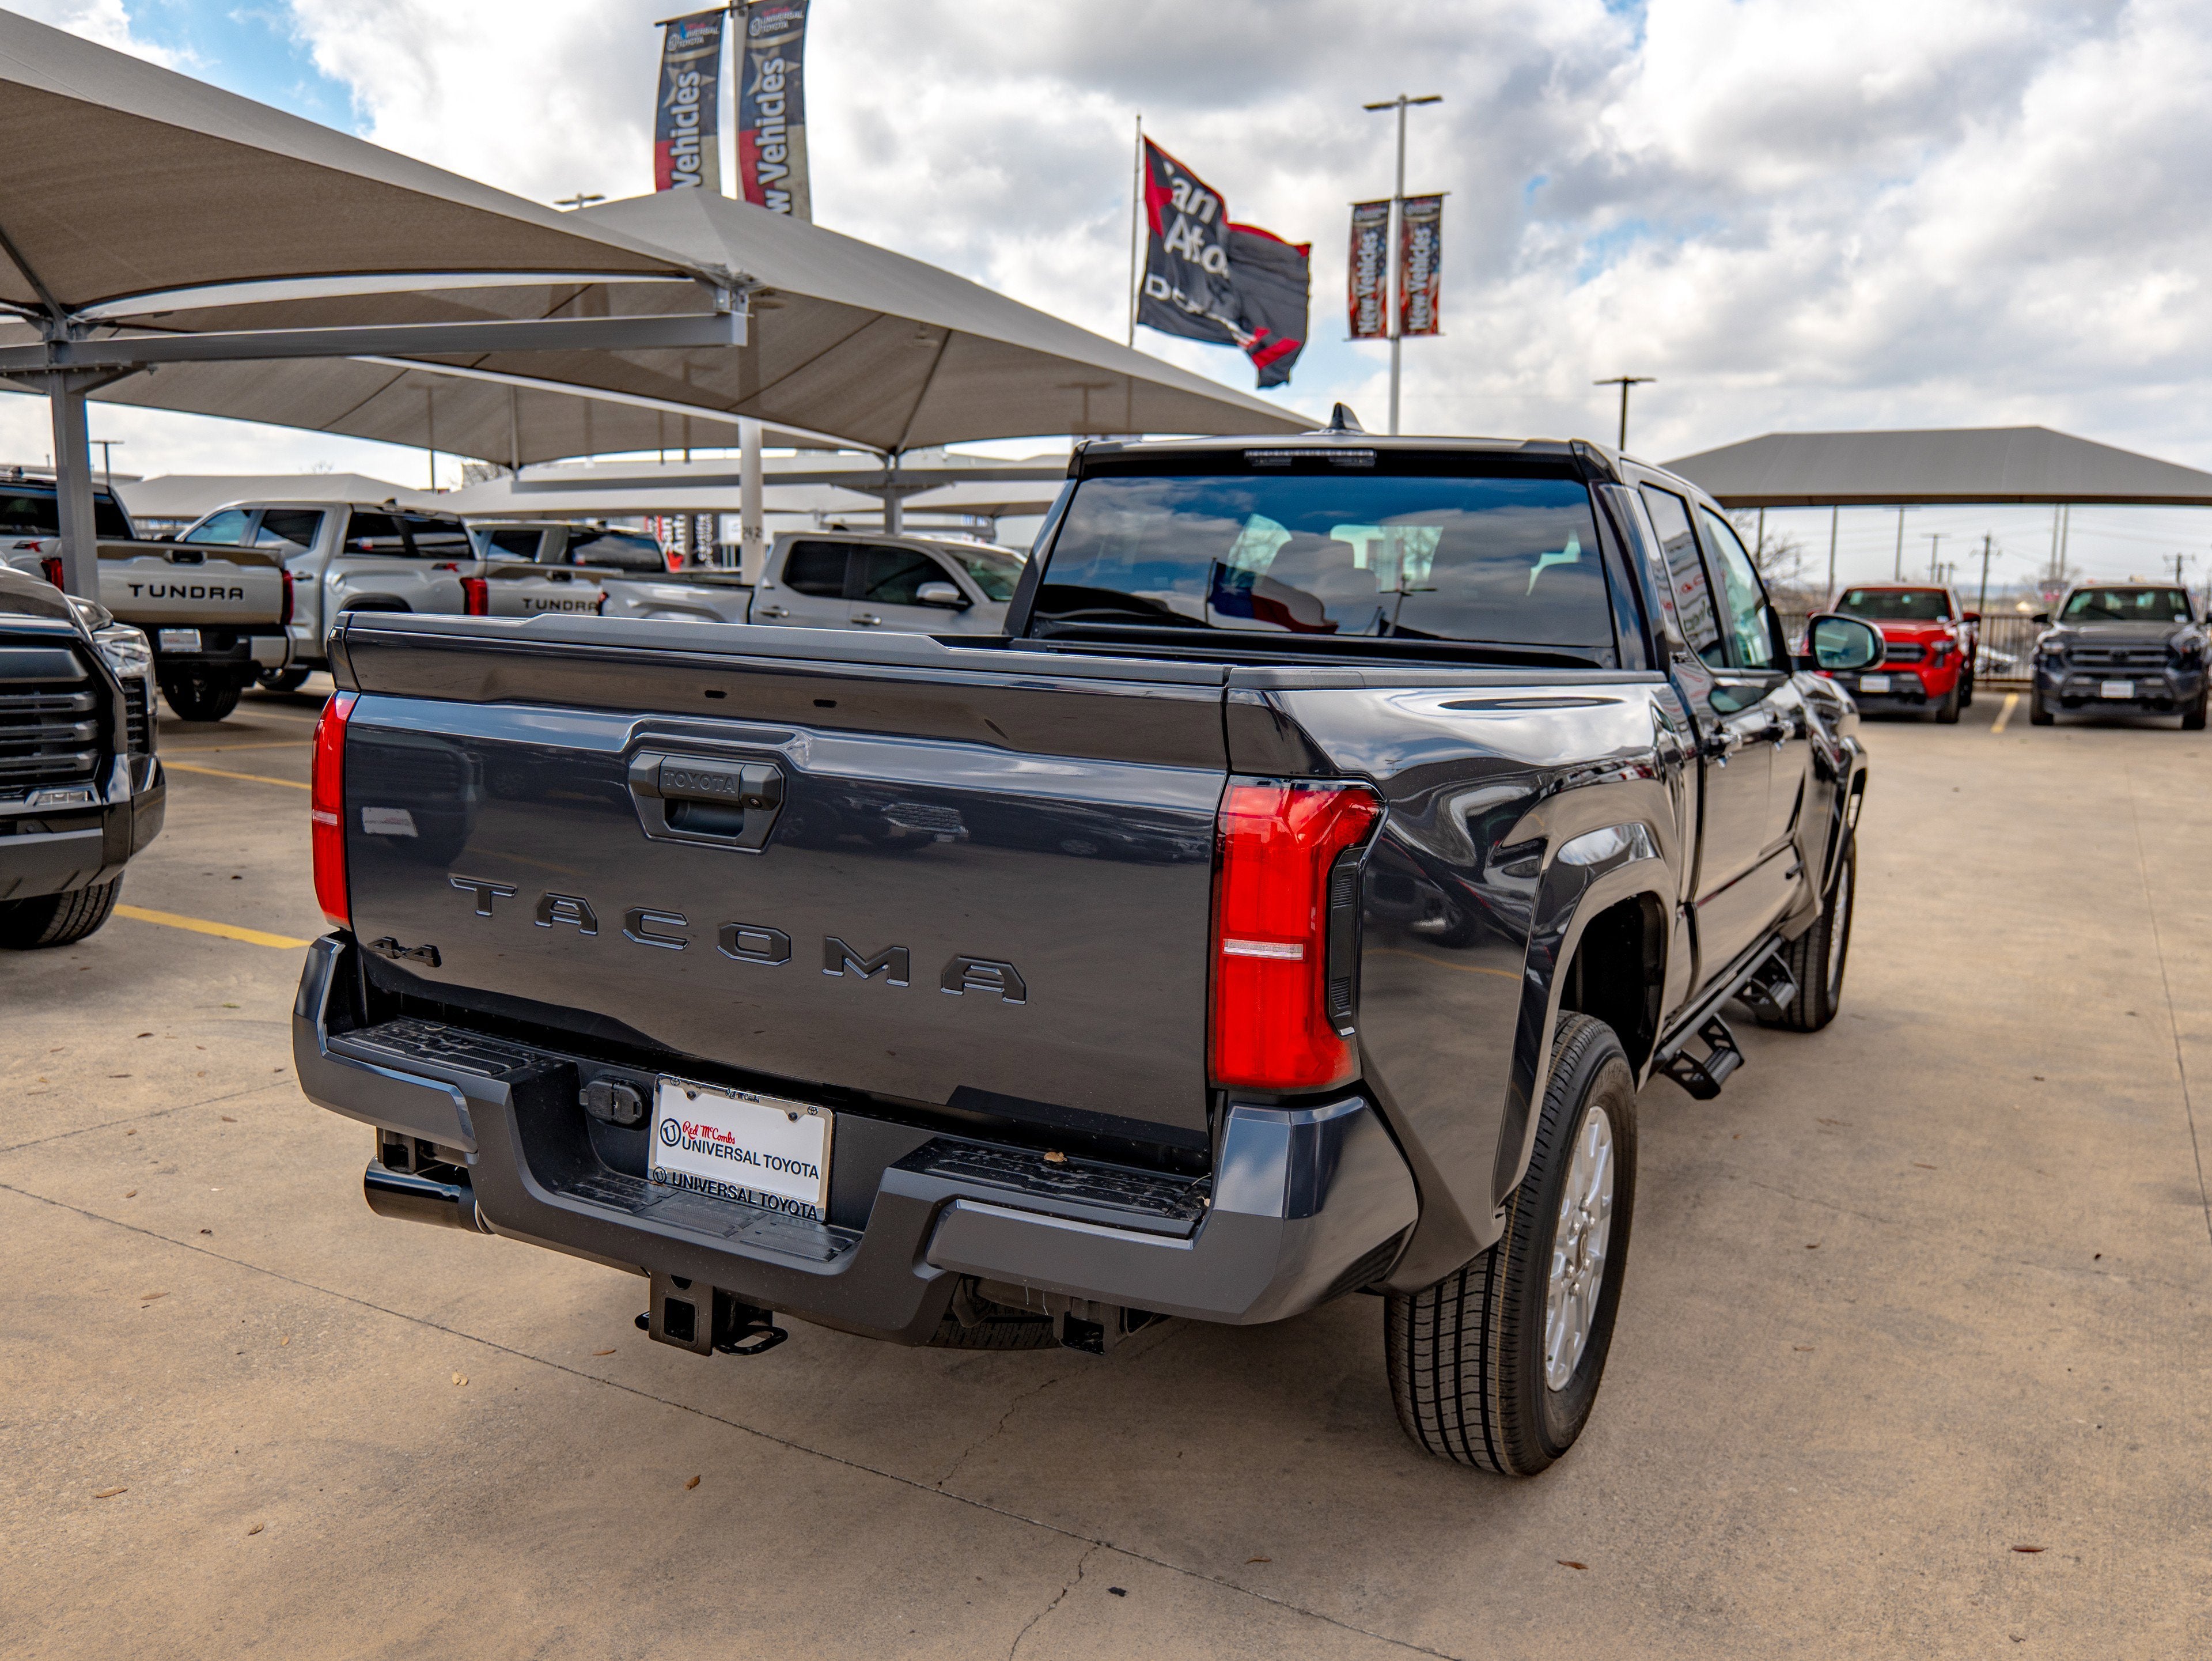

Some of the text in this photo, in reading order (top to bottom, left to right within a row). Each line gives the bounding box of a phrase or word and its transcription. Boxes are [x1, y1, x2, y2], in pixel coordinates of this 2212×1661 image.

[669, 70, 702, 190] Vehicles
[754, 57, 789, 186] Vehicles
[1357, 232, 1378, 298] Vehicles
[1408, 227, 1431, 294] Vehicles
[128, 584, 244, 600] TUNDRA
[522, 597, 599, 612] TUNDRA
[664, 770, 736, 794] TOYOTA
[448, 873, 1028, 1005] TACOMA
[682, 1136, 819, 1180] UNIVERSAL TOYOTA
[683, 1121, 735, 1145] Red McCombs
[672, 1171, 818, 1221] UNIVERSAL TOYOTA
